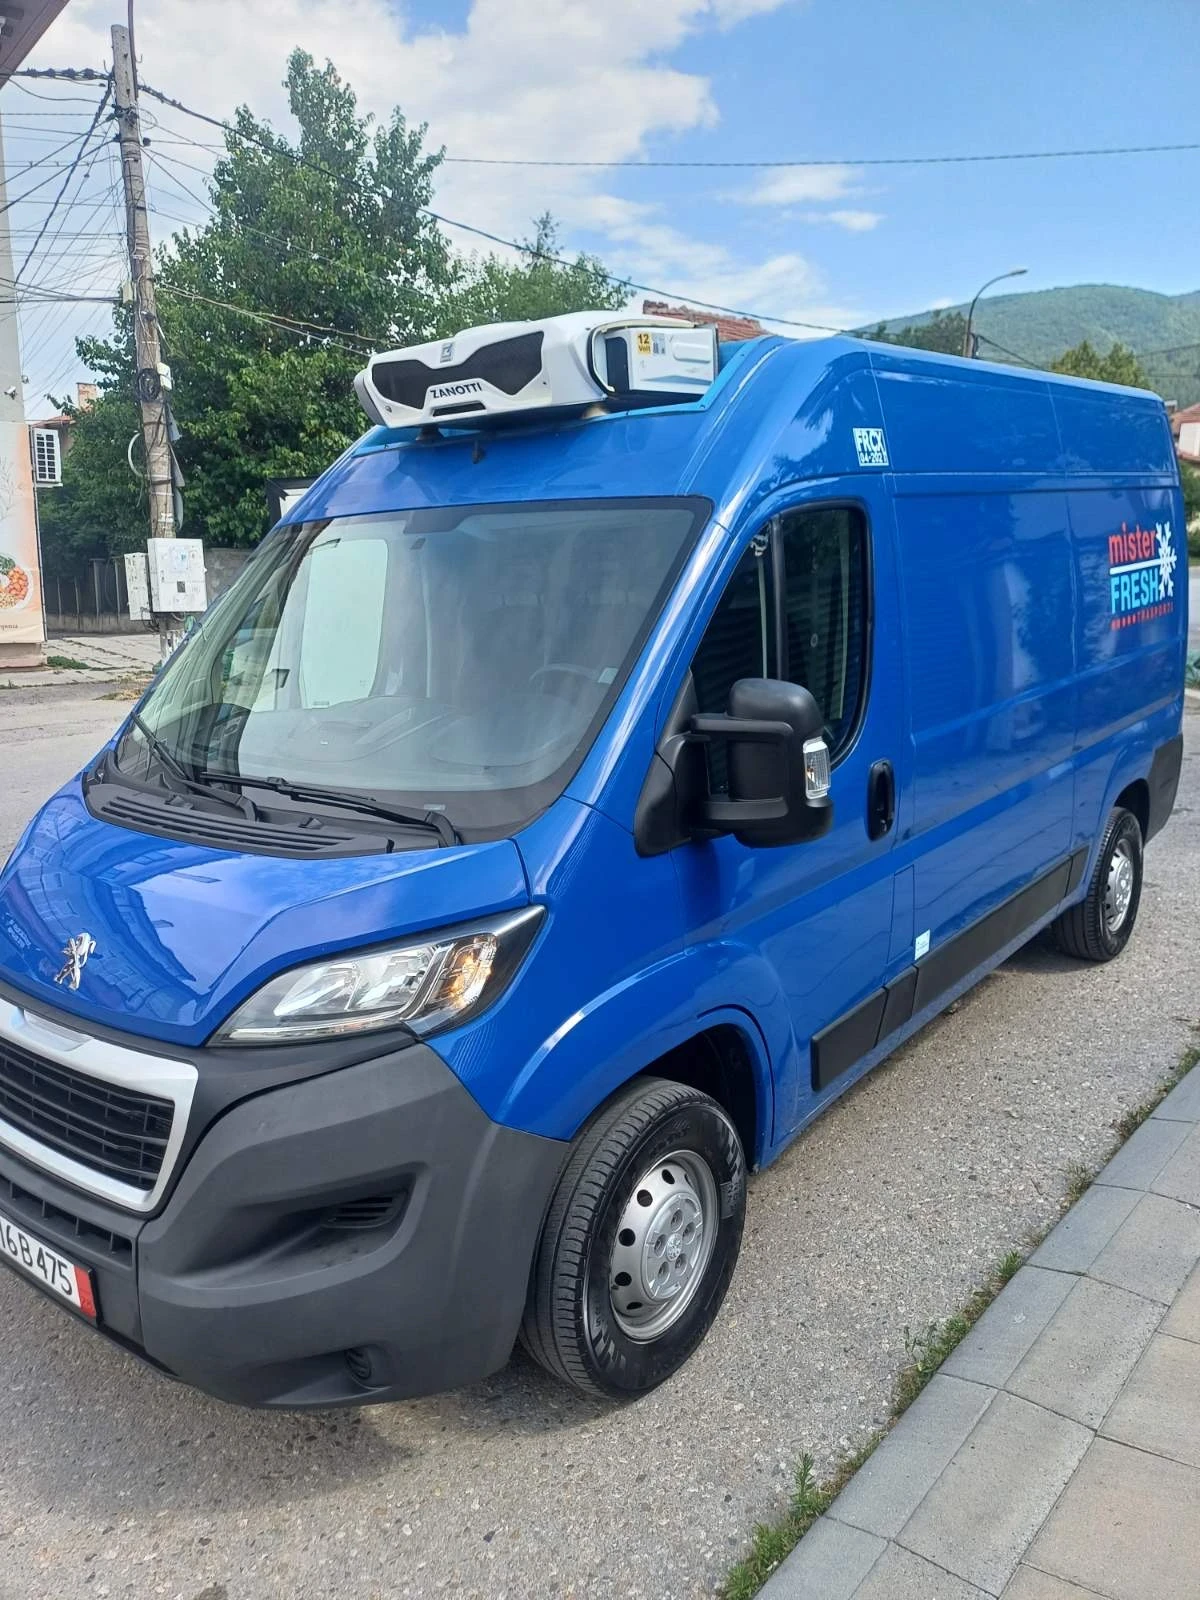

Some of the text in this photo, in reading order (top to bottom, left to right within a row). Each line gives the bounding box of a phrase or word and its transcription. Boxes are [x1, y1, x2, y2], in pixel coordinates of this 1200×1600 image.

[638, 333, 650, 344] 12
[638, 344, 651, 353] Volt
[430, 382, 482, 399] ZANOTTI
[1108, 521, 1156, 565] mister
[1110, 567, 1159, 614] FRESH
